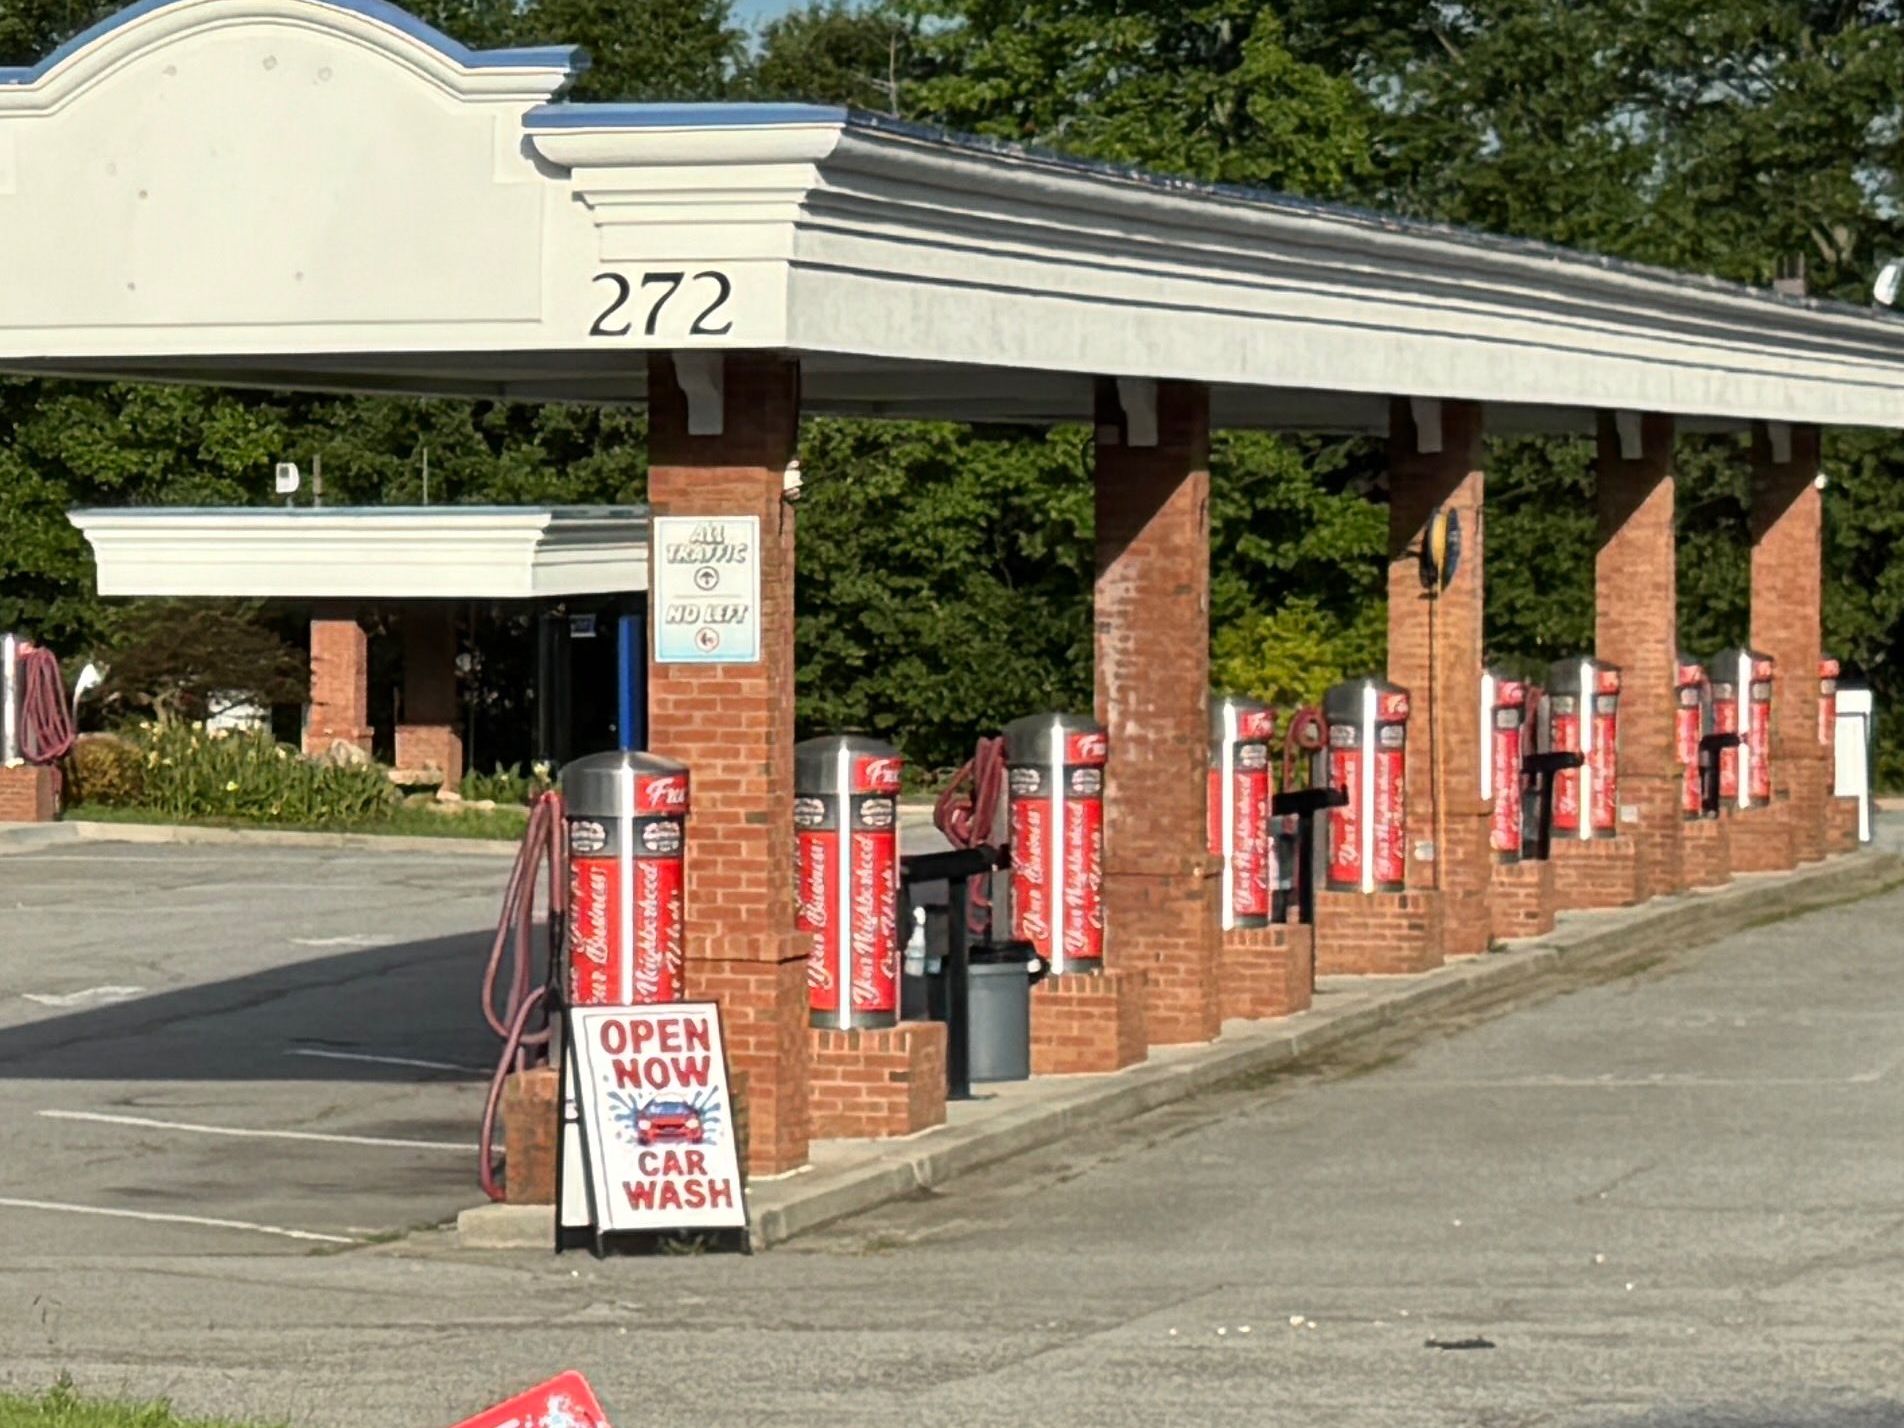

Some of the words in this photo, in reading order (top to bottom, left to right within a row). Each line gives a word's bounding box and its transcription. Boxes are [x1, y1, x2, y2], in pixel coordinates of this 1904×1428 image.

[589, 270, 733, 336] 272
[688, 524, 725, 545] ALL
[665, 604, 701, 624] NO
[703, 603, 749, 624] LEFT
[600, 1018, 711, 1054] OPEN
[612, 1056, 711, 1090] NOW
[638, 1150, 707, 1176] CAR
[622, 1178, 733, 1211] WASH
